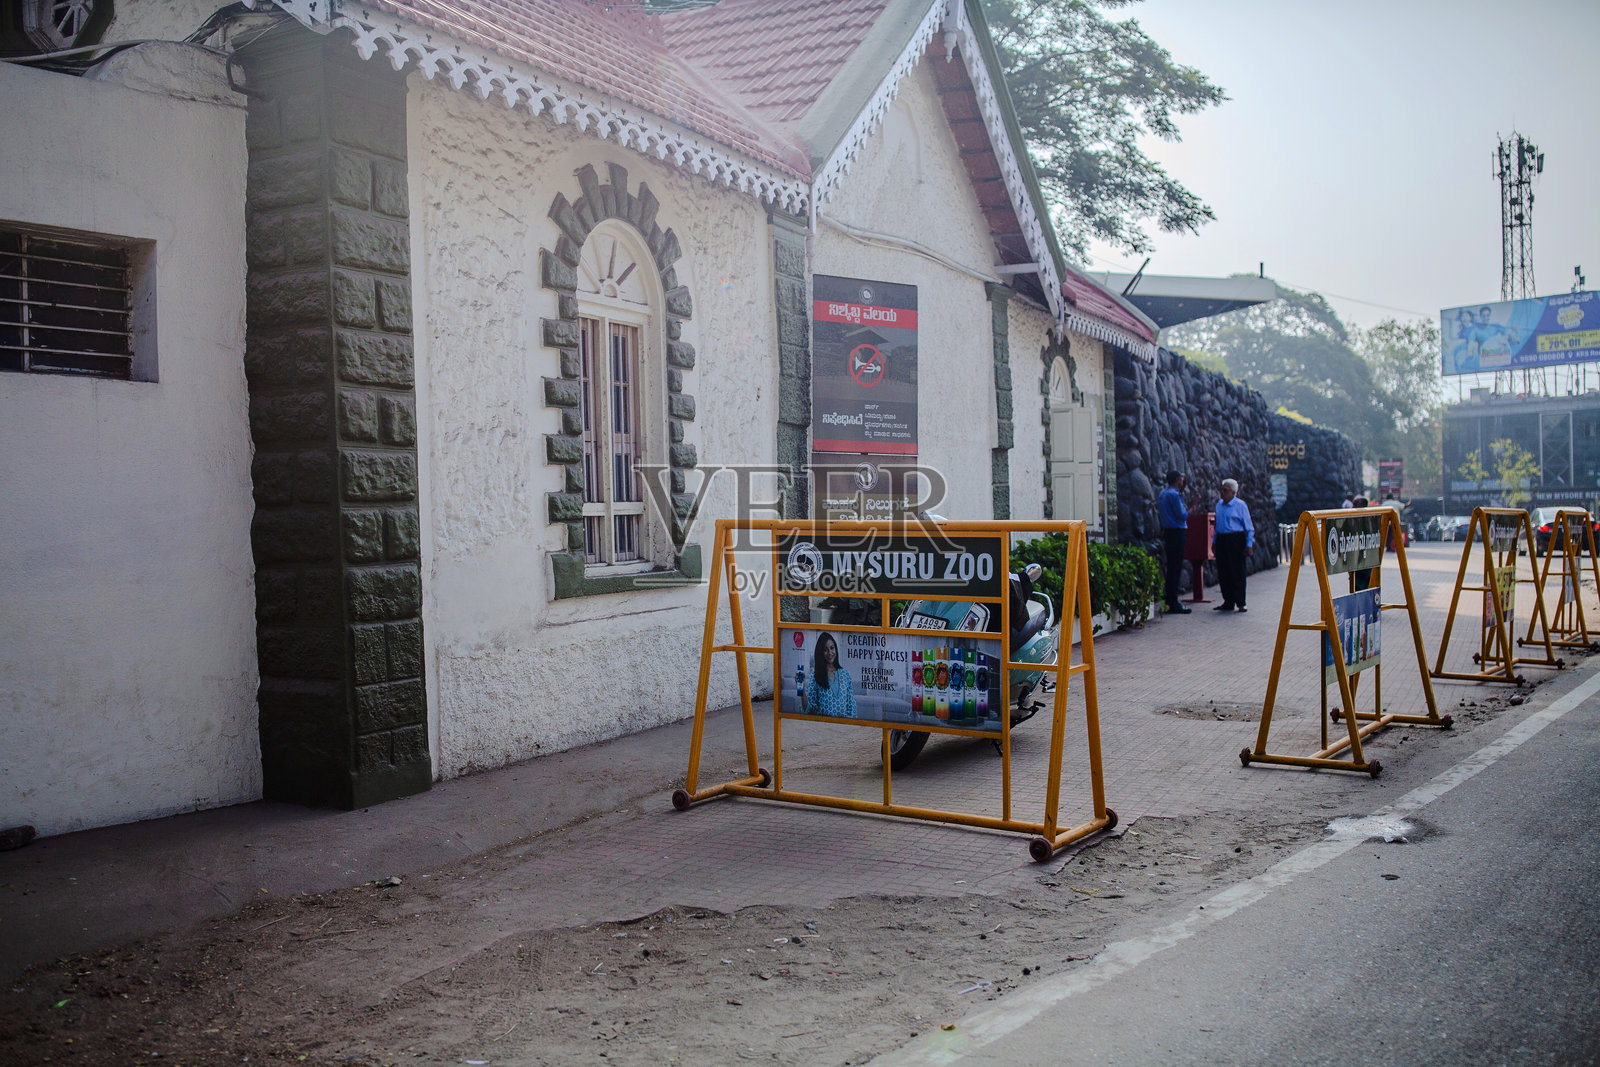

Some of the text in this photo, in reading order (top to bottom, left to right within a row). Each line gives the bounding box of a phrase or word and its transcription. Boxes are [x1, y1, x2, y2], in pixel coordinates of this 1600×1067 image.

[863, 307, 897, 322] ವಲಯ
[832, 551, 934, 580] MYSURU
[943, 552, 994, 582] ZOO
[847, 634, 887, 648] CREATING
[847, 648, 908, 662] HAPPY SPACES!
[861, 666, 895, 676] PRESENTING
[871, 675, 889, 683] ROOM
[861, 682, 896, 692] FRESHENERS.
